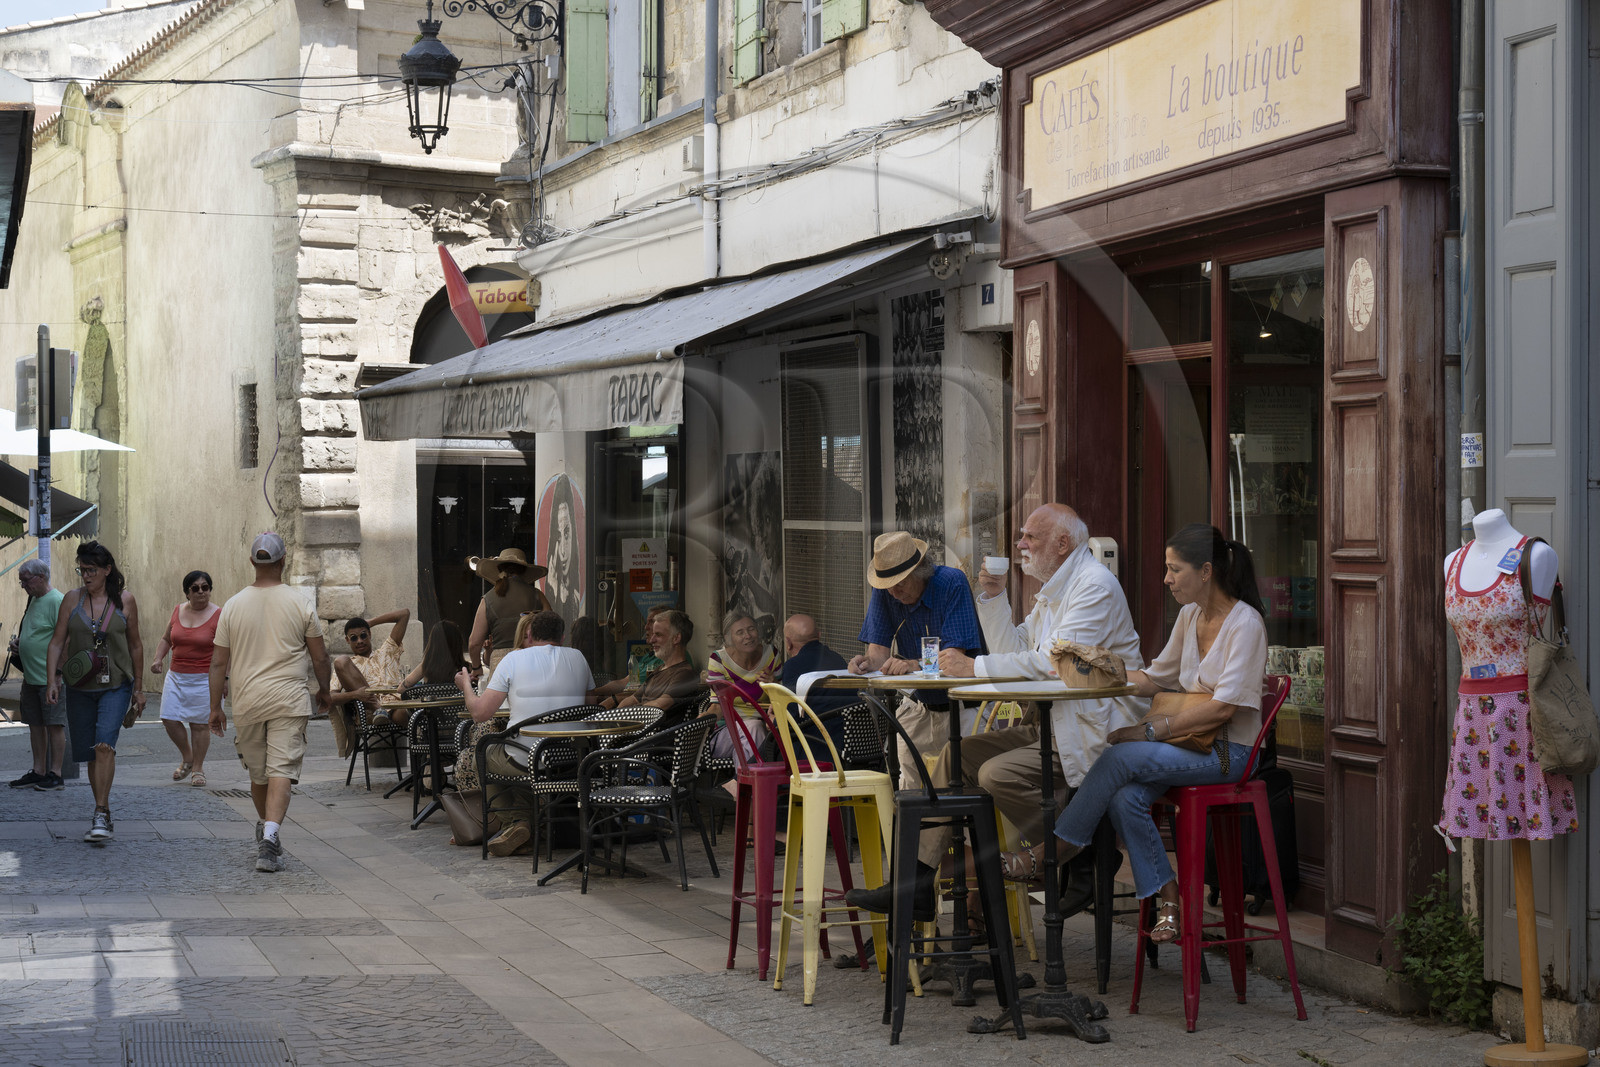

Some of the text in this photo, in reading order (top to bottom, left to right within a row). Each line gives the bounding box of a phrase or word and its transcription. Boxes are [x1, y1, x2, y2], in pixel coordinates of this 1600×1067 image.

[1166, 34, 1304, 119] La boutique
[1039, 69, 1100, 136] CAFÉS
[1197, 116, 1242, 156] depuis
[1065, 140, 1170, 190] Torréfaction artisanale
[475, 287, 527, 305] Tabac
[985, 285, 990, 302] 7
[491, 384, 530, 430] TABAC
[608, 370, 663, 424] TABAC
